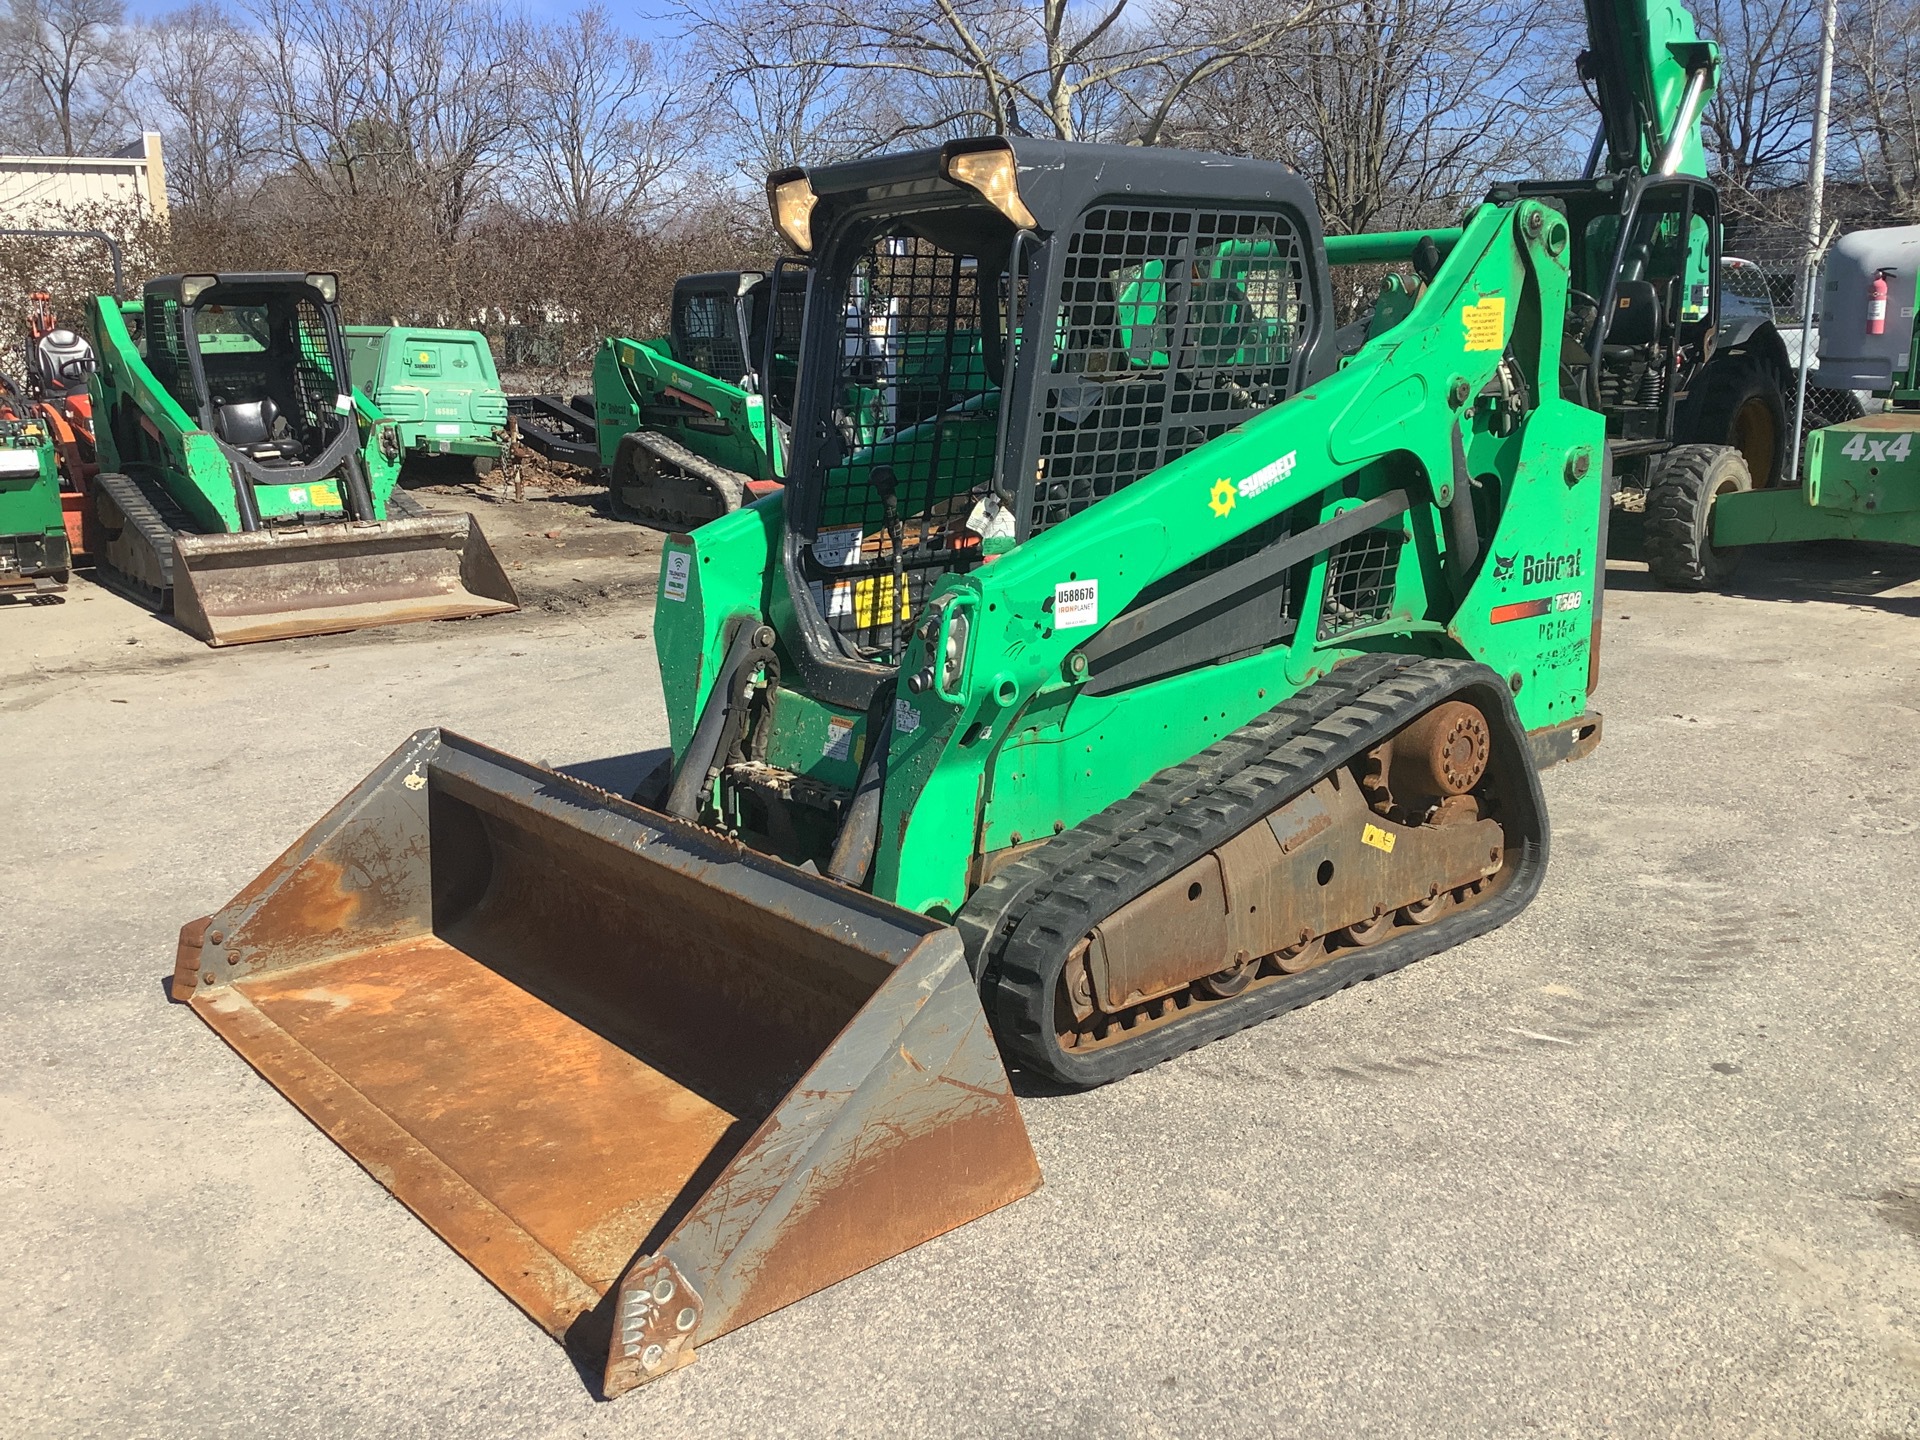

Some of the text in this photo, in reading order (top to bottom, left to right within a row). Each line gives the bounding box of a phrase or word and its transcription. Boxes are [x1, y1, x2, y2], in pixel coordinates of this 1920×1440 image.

[1841, 432, 1913, 463] 4x4
[1238, 449, 1297, 498] SUNBELT
[1248, 469, 1292, 500] RENTALS
[1522, 548, 1582, 586] Bobcat
[1058, 586, 1094, 603] U588676
[1058, 602, 1094, 613] IRONPLANET
